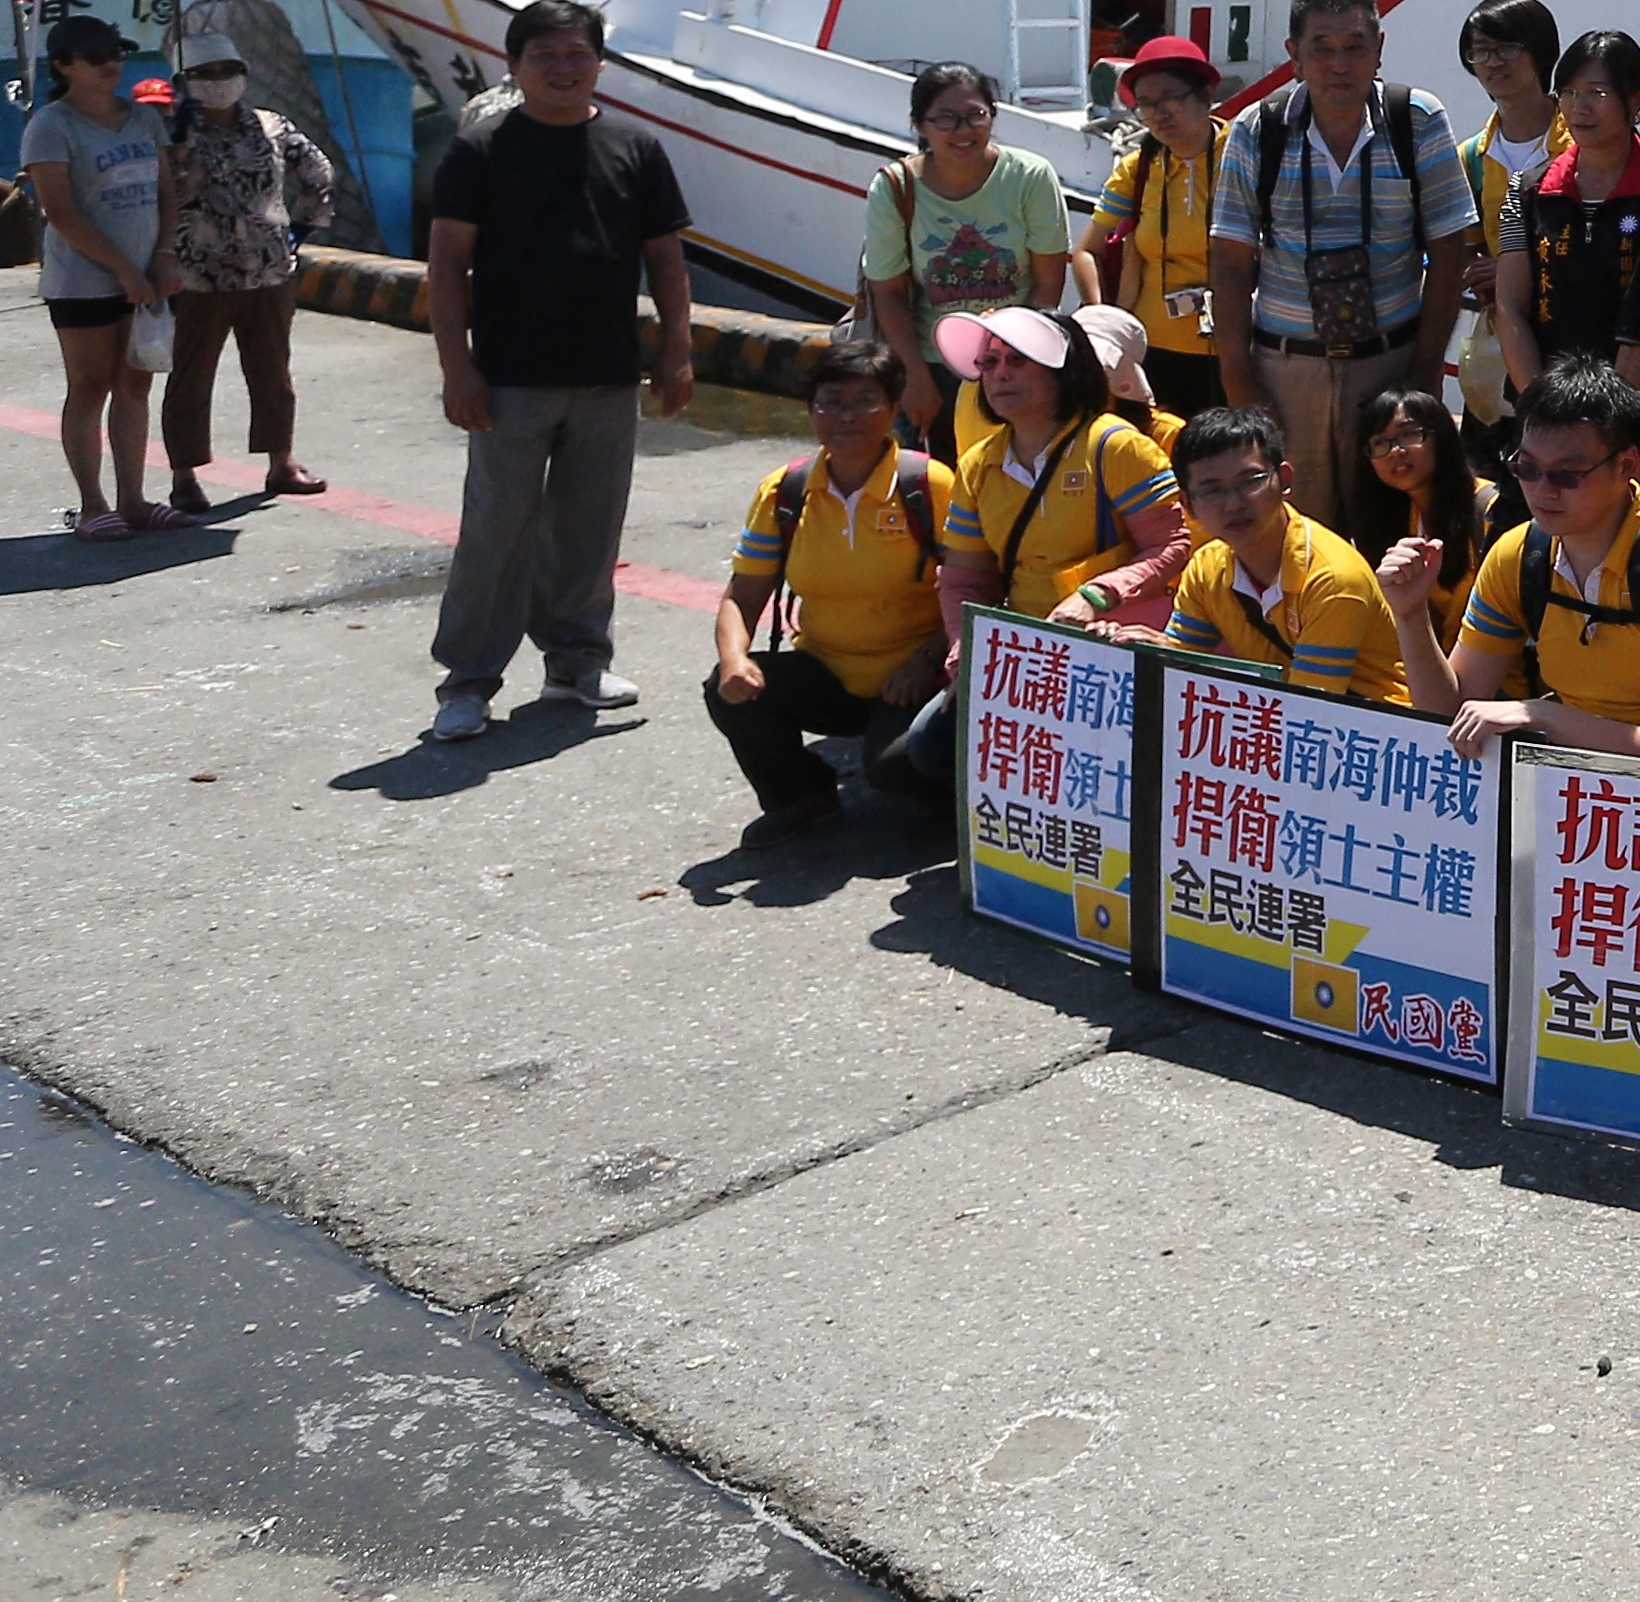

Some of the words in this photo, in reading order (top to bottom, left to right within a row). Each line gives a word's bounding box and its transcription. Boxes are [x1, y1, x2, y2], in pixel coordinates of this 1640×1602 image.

[1177, 679, 1483, 826] 抗議南海仲裁
[975, 792, 1103, 880] 全民連署
[1172, 771, 1478, 919] 捍衛領土主權
[1168, 858, 1328, 954] 全民連署
[1362, 983, 1487, 1064] 民國黨
